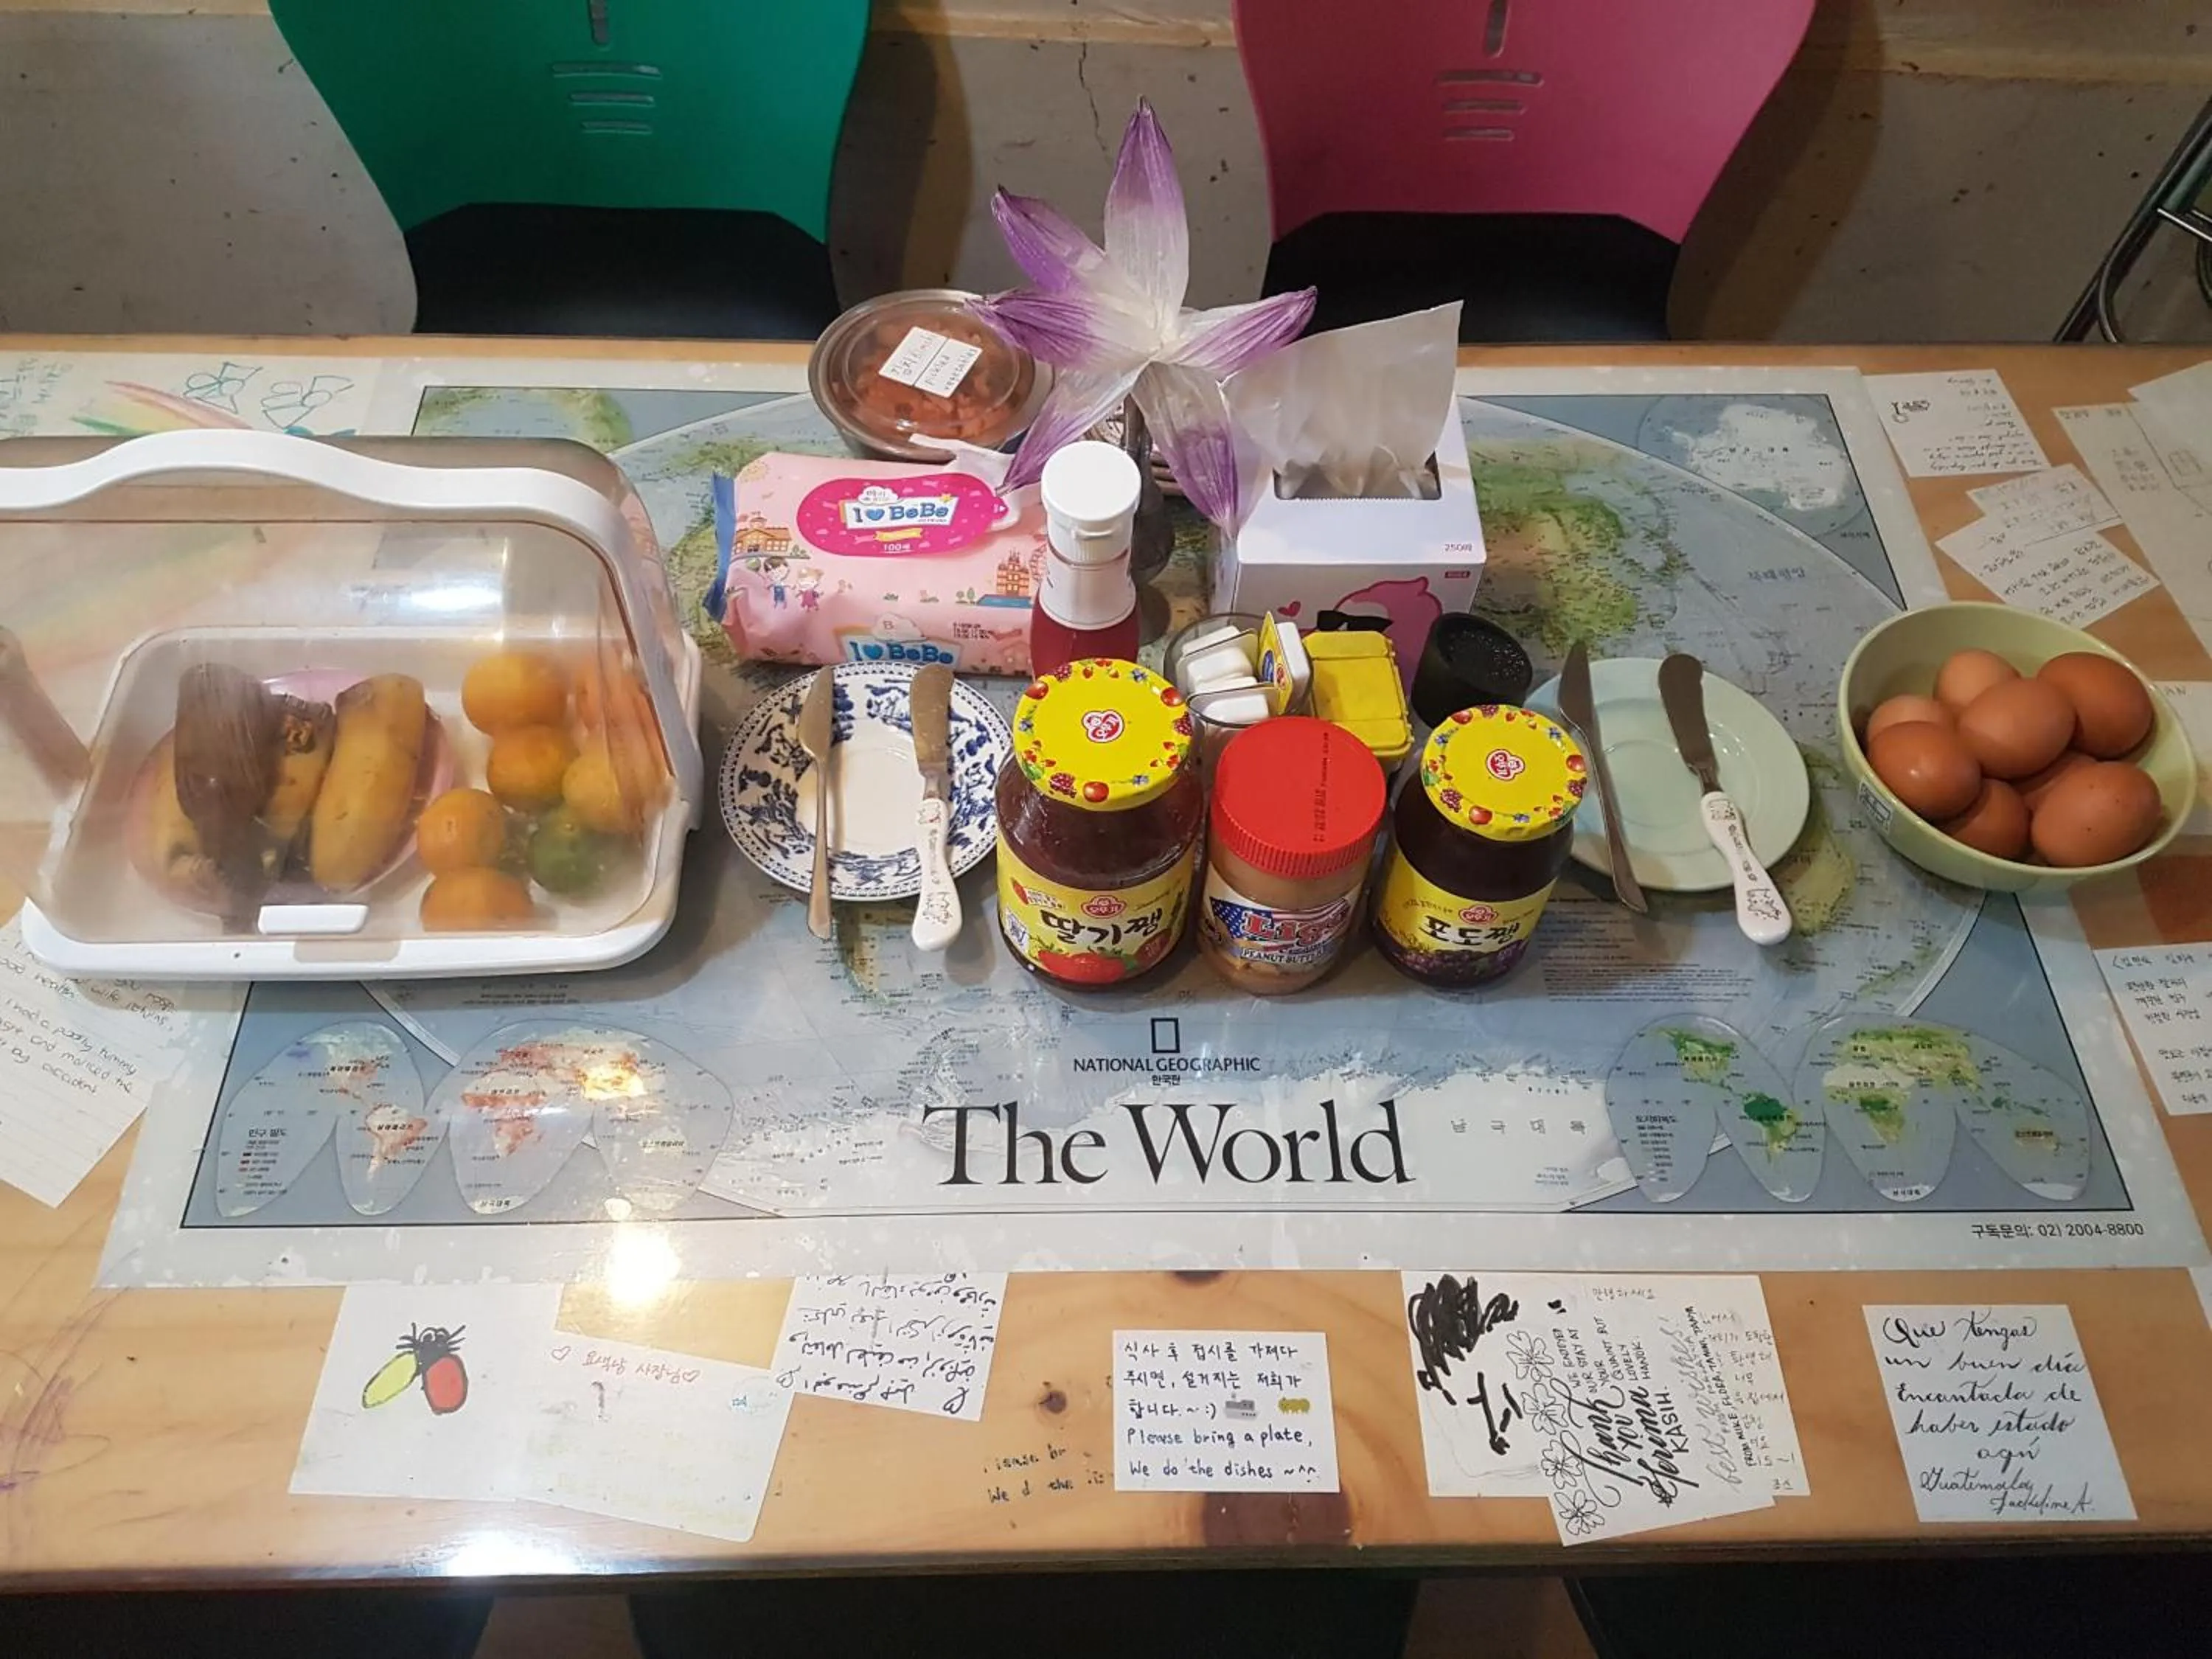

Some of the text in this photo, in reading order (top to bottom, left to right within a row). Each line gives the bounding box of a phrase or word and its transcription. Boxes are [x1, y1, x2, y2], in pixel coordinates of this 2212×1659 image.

[1074, 1057, 1261, 1072] NATIONAL GEOGRAPHIC
[1151, 1074, 1180, 1087] 한국판
[922, 1099, 1417, 1186] The World
[1971, 1222, 2144, 1239] 구독문의: 02) 2004-8800
[1567, 1327, 1579, 1340] AT
[1882, 1315, 1947, 1349] Que
[1123, 1340, 1160, 1362] 식사
[1167, 1341, 1180, 1363] 후
[1191, 1341, 1239, 1363] 접시를
[1571, 1343, 1589, 1368] STAY
[1616, 1343, 1638, 1382] LOVELY
[1885, 1356, 1931, 1369] un
[1947, 1351, 2023, 1372] buen
[1123, 1369, 1303, 1391] 주시면, 설거지는 저희가
[1896, 1374, 2082, 1403] Encantada de
[1905, 1406, 2076, 1438] haber estado
[1127, 1427, 1183, 1446] Please
[1193, 1427, 1235, 1450] bring
[1243, 1432, 1254, 1444] a
[1130, 1458, 1150, 1476] We
[1163, 1458, 1178, 1476] do
[1188, 1458, 1214, 1478] the
[1223, 1457, 1273, 1479] dishes
